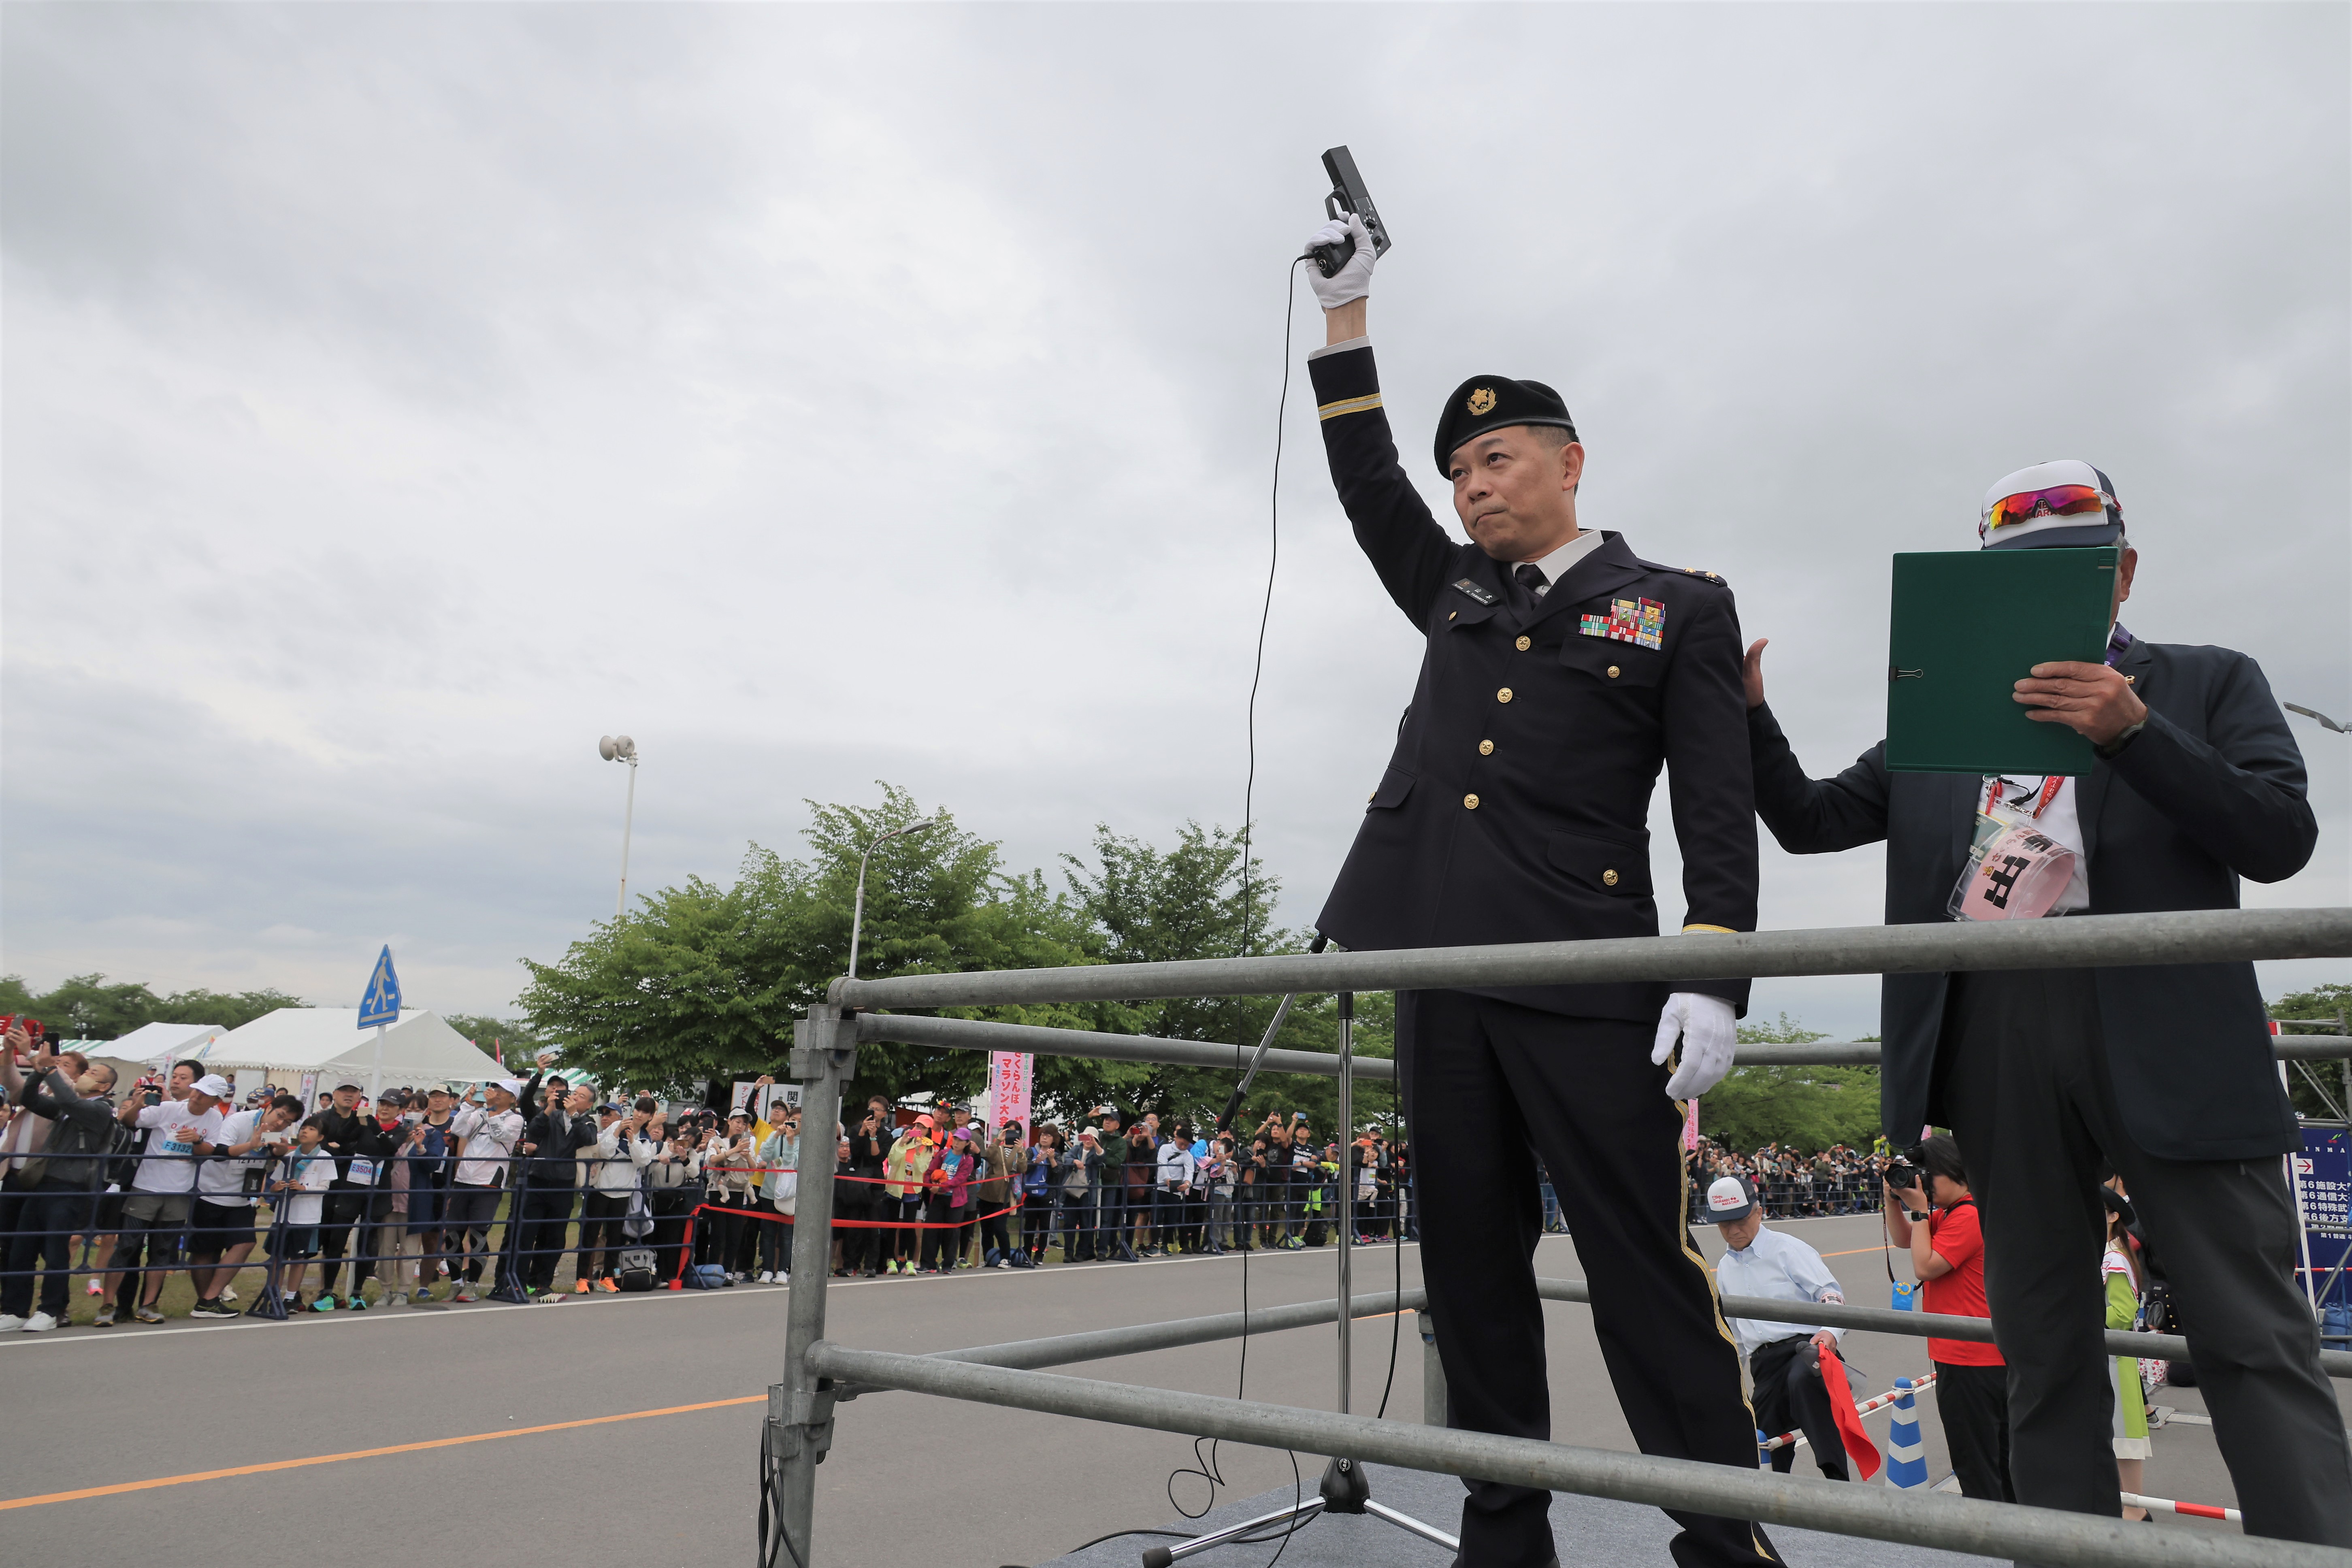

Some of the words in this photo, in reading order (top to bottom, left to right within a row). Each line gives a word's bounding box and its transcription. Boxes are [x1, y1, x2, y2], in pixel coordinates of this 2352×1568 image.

[1470, 592, 1488, 604] YAMAMOTO
[1474, 588, 1493, 599] 山本
[165, 1142, 191, 1153] F3132
[352, 1164, 372, 1174] E3504
[2301, 1191, 2350, 1202] 第6通信大
[2302, 1201, 2349, 1212] 第6特殊武
